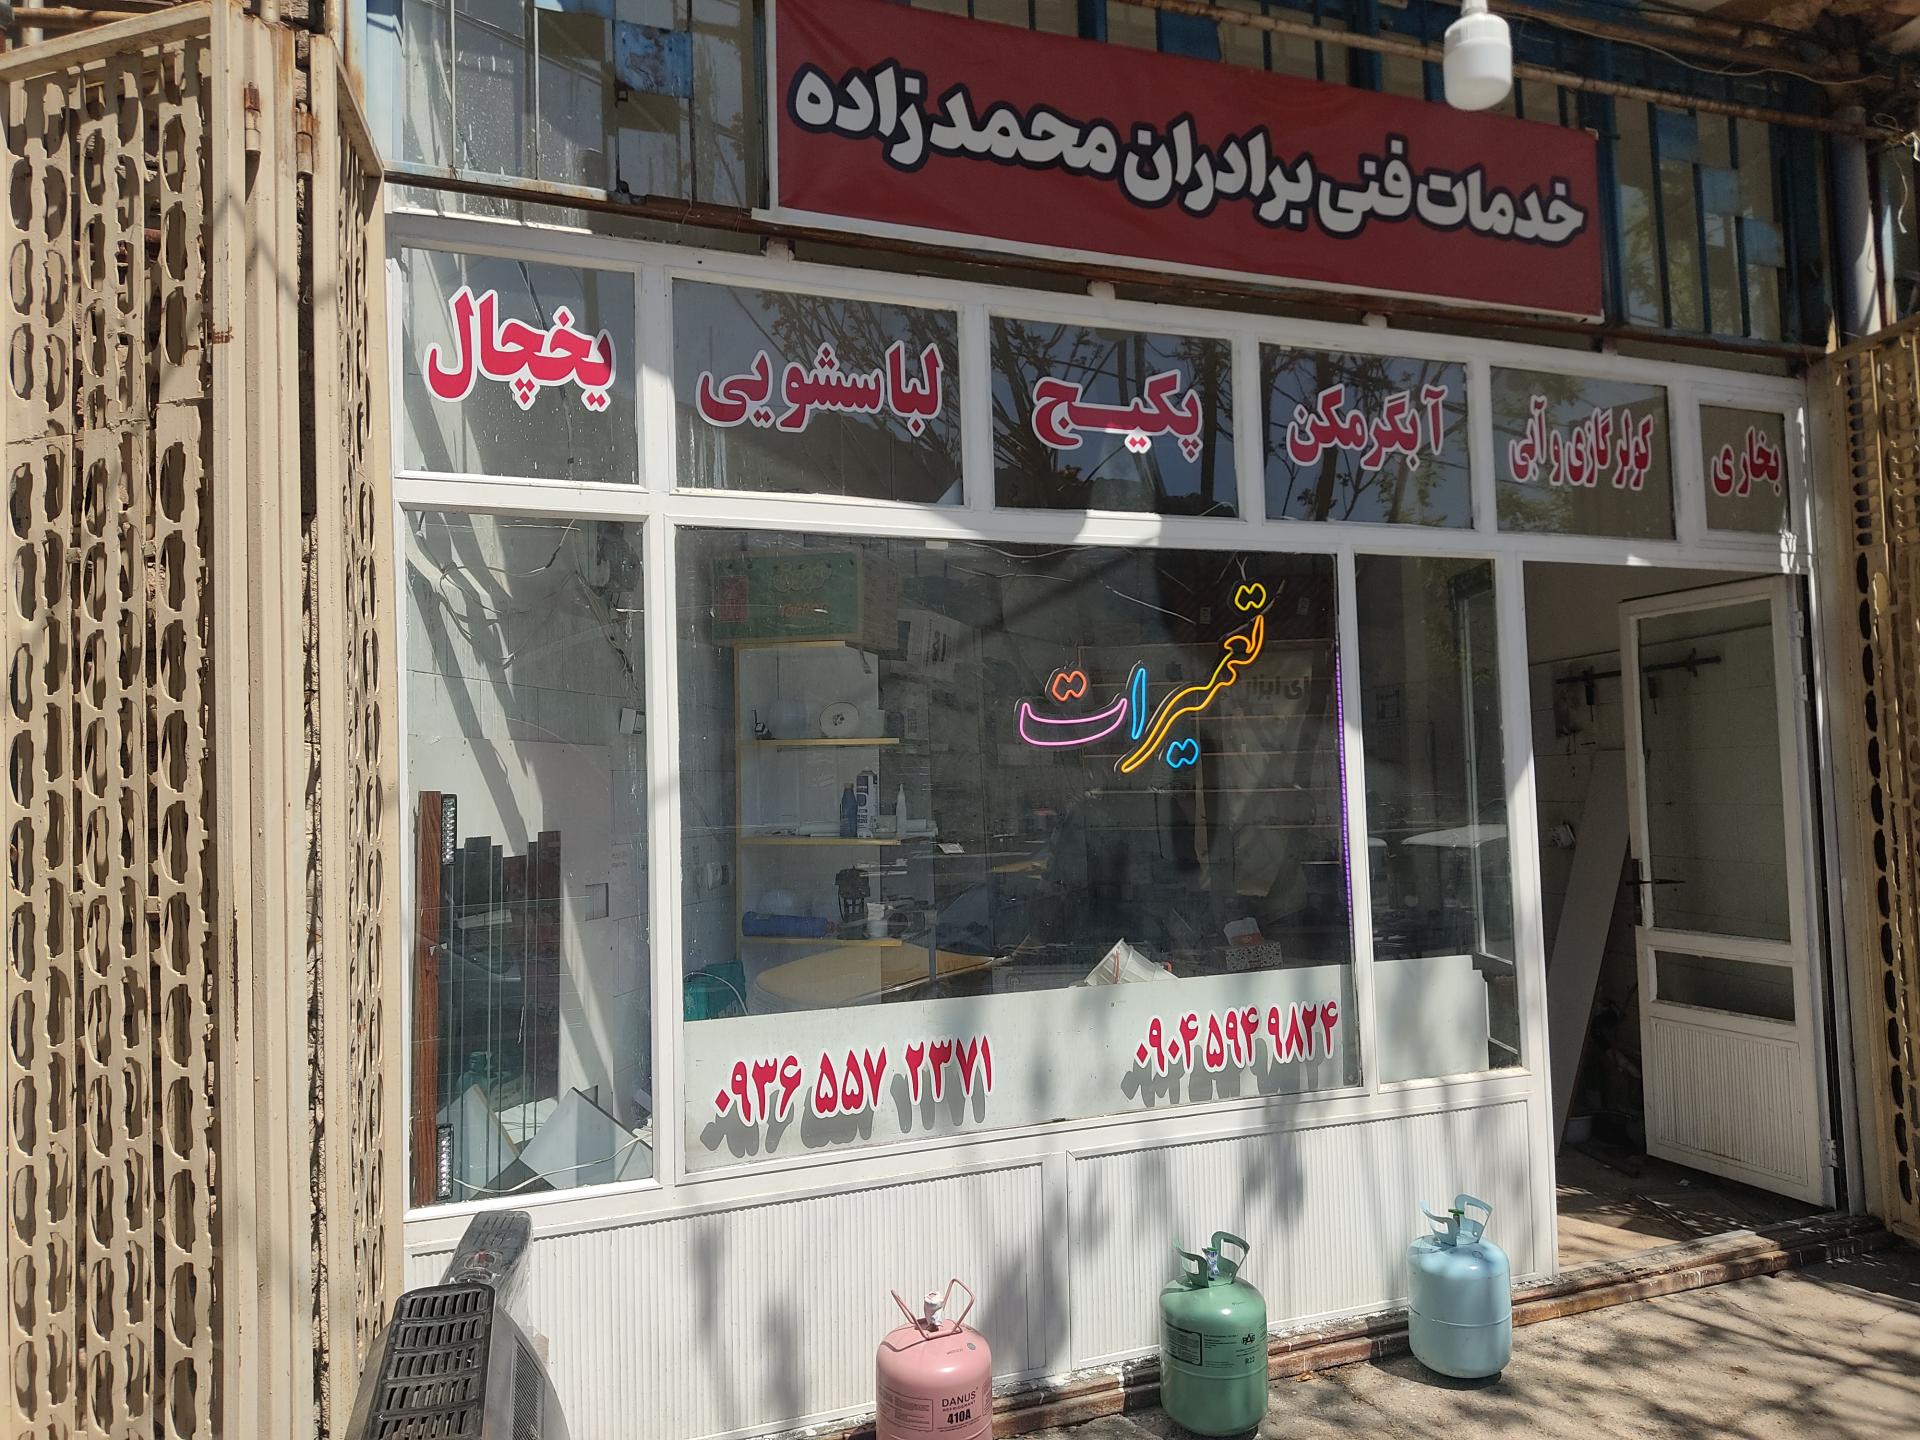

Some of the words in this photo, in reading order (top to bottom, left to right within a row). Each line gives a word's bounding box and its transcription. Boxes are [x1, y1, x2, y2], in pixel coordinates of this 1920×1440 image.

[1122, 120, 1312, 224] برادران
[1317, 141, 1411, 233] فنی
[1416, 171, 1584, 242] خدمات
[426, 290, 613, 408] یخچال
[700, 342, 941, 434] لباسشویی
[1288, 385, 1446, 469] آبگرمکن
[1511, 396, 1546, 481] آبی
[1551, 430, 1561, 485] و
[1568, 408, 1611, 486] گازی
[1615, 411, 1652, 488] کولر
[1712, 427, 1781, 495] بخاری
[1019, 582, 1267, 774] تعمیرات
[1135, 1012, 1200, 1073] ۰۹۰۴
[1204, 1006, 1261, 1069] ۵۹۴
[1266, 1001, 1340, 1060] ۹۸۲۴
[714, 1054, 803, 1122] ۰۹۳۶
[814, 1046, 888, 1115] ۵۵۷
[904, 1036, 993, 1102] ۲۳۷۱
[941, 1390, 976, 1408] DANUS
[947, 1408, 971, 1425] 410A
